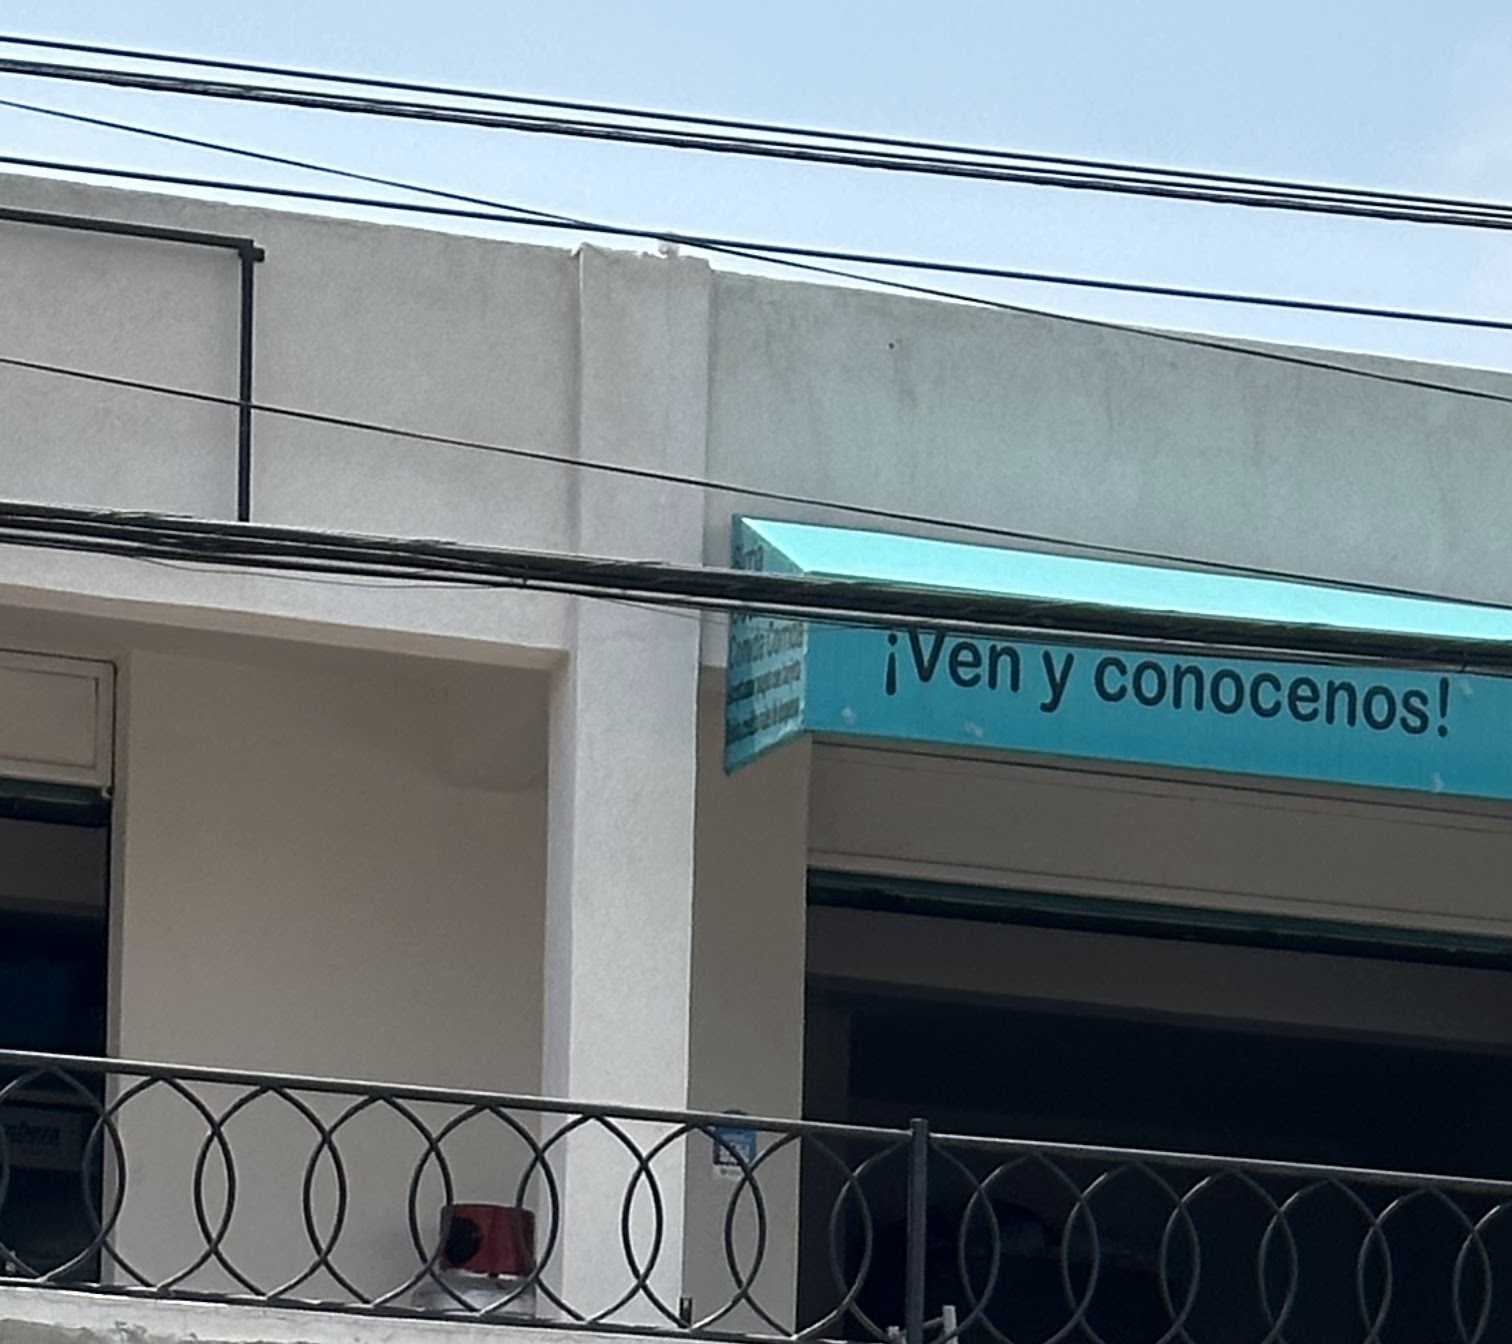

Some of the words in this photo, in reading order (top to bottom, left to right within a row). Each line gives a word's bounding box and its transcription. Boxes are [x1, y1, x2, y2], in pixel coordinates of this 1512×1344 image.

[884, 628, 1022, 697] ¡Ven
[1040, 652, 1075, 714] y
[1094, 653, 1450, 737] conocenos!
